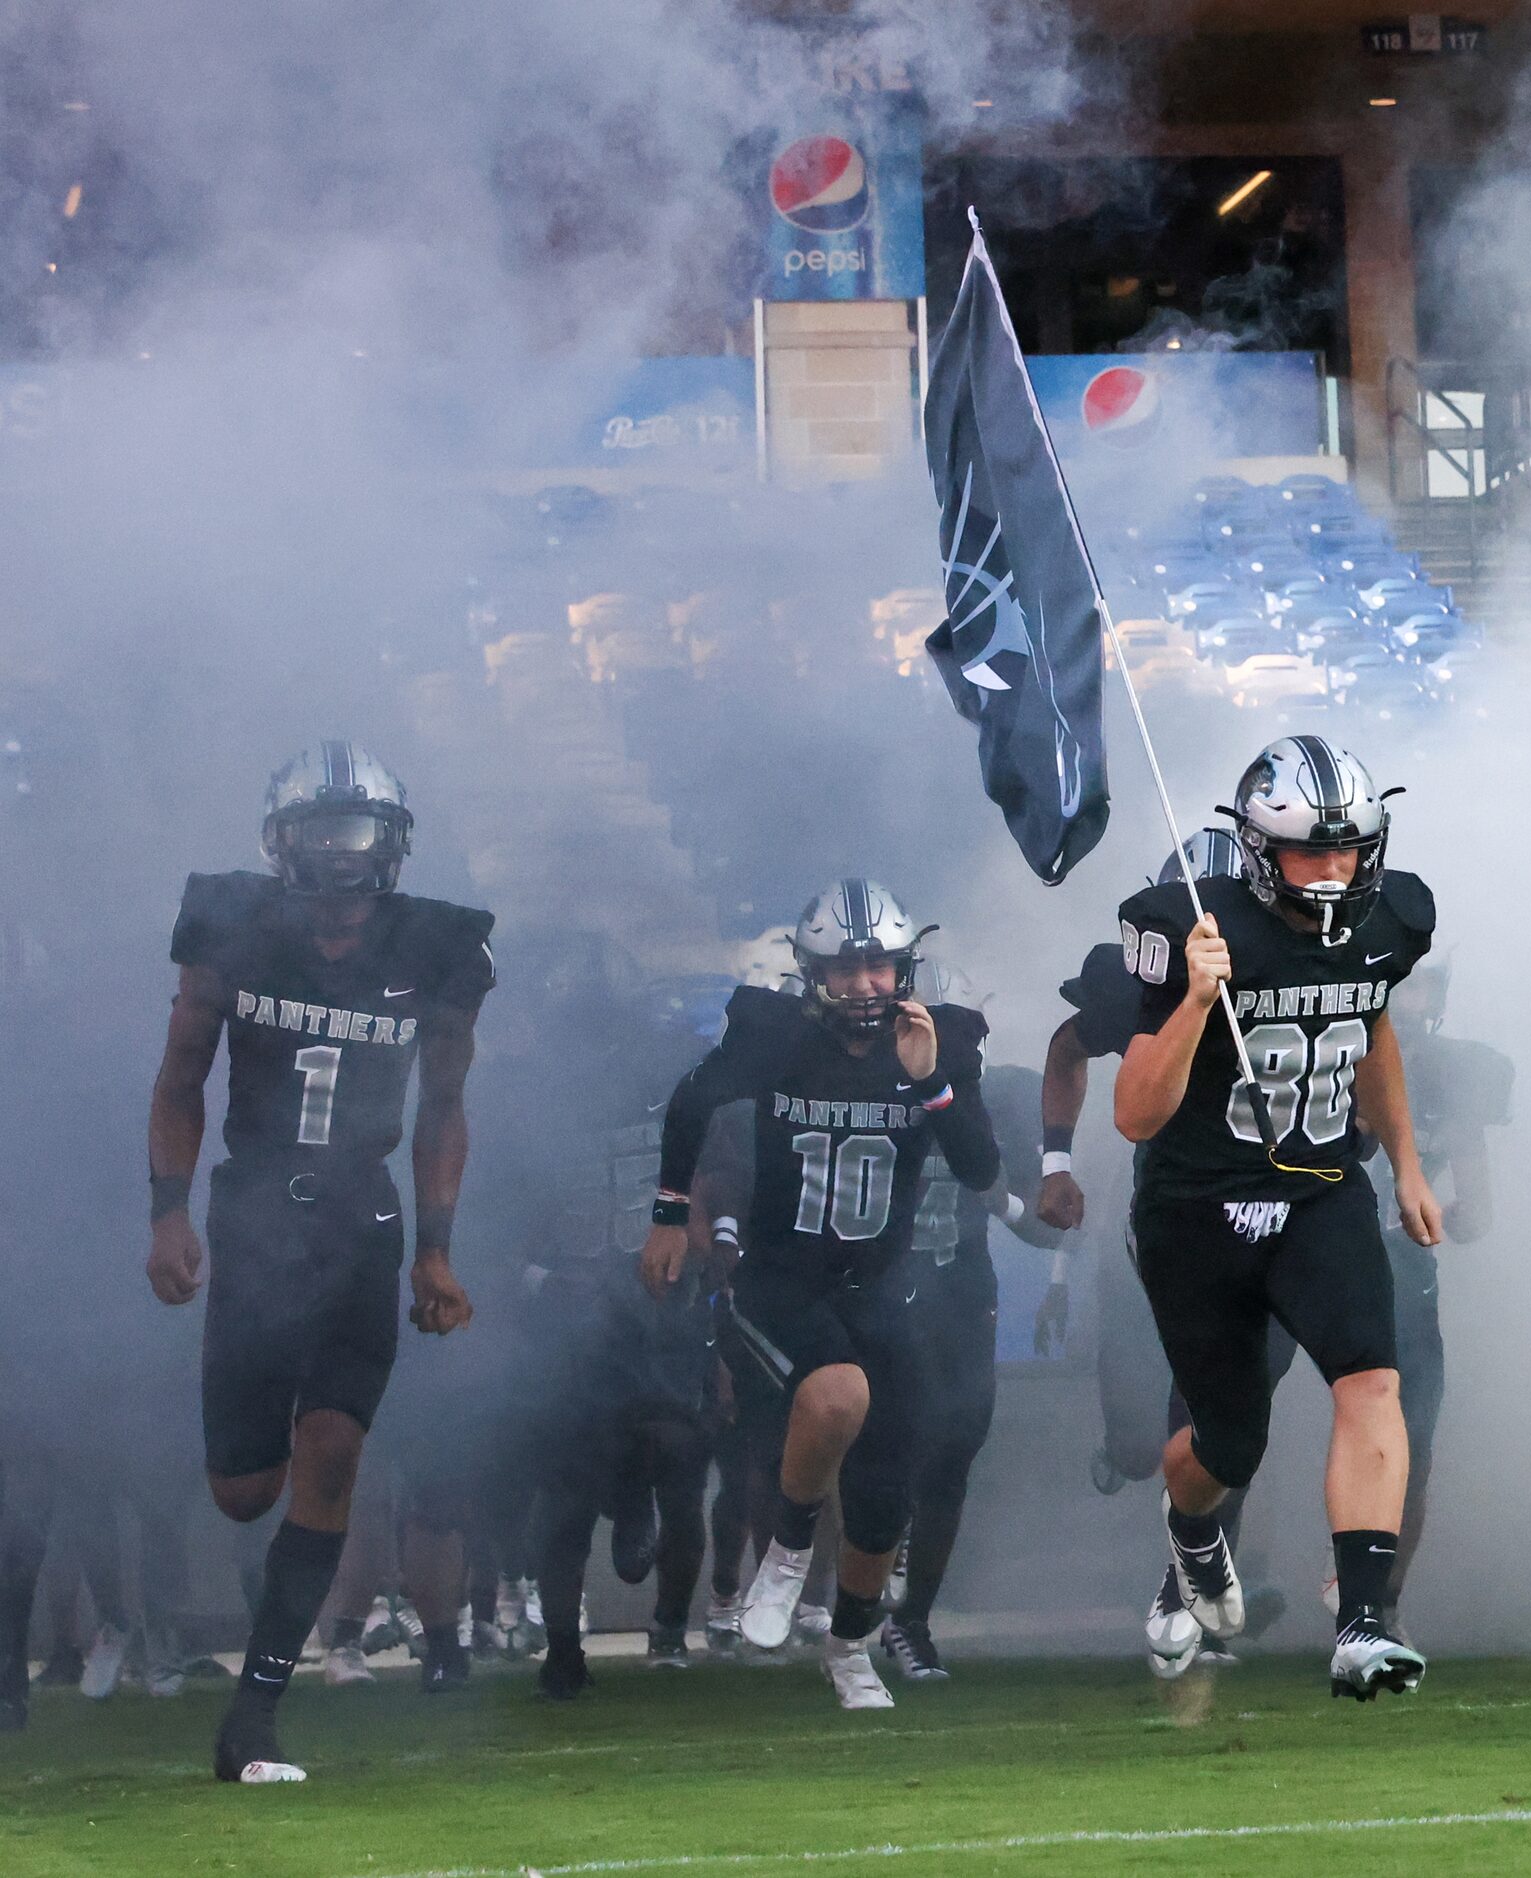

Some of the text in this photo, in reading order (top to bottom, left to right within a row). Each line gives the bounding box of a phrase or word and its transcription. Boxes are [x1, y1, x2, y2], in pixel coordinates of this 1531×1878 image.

[1448, 33, 1478, 50] 117
[784, 247, 866, 277] pepsi
[1121, 919, 1170, 984] 80
[237, 990, 417, 1046] PANTHERS
[1235, 980, 1388, 1018] PANTHERS
[295, 1045, 342, 1144] 1
[1226, 1018, 1367, 1145] 80
[792, 1131, 898, 1240] 10
